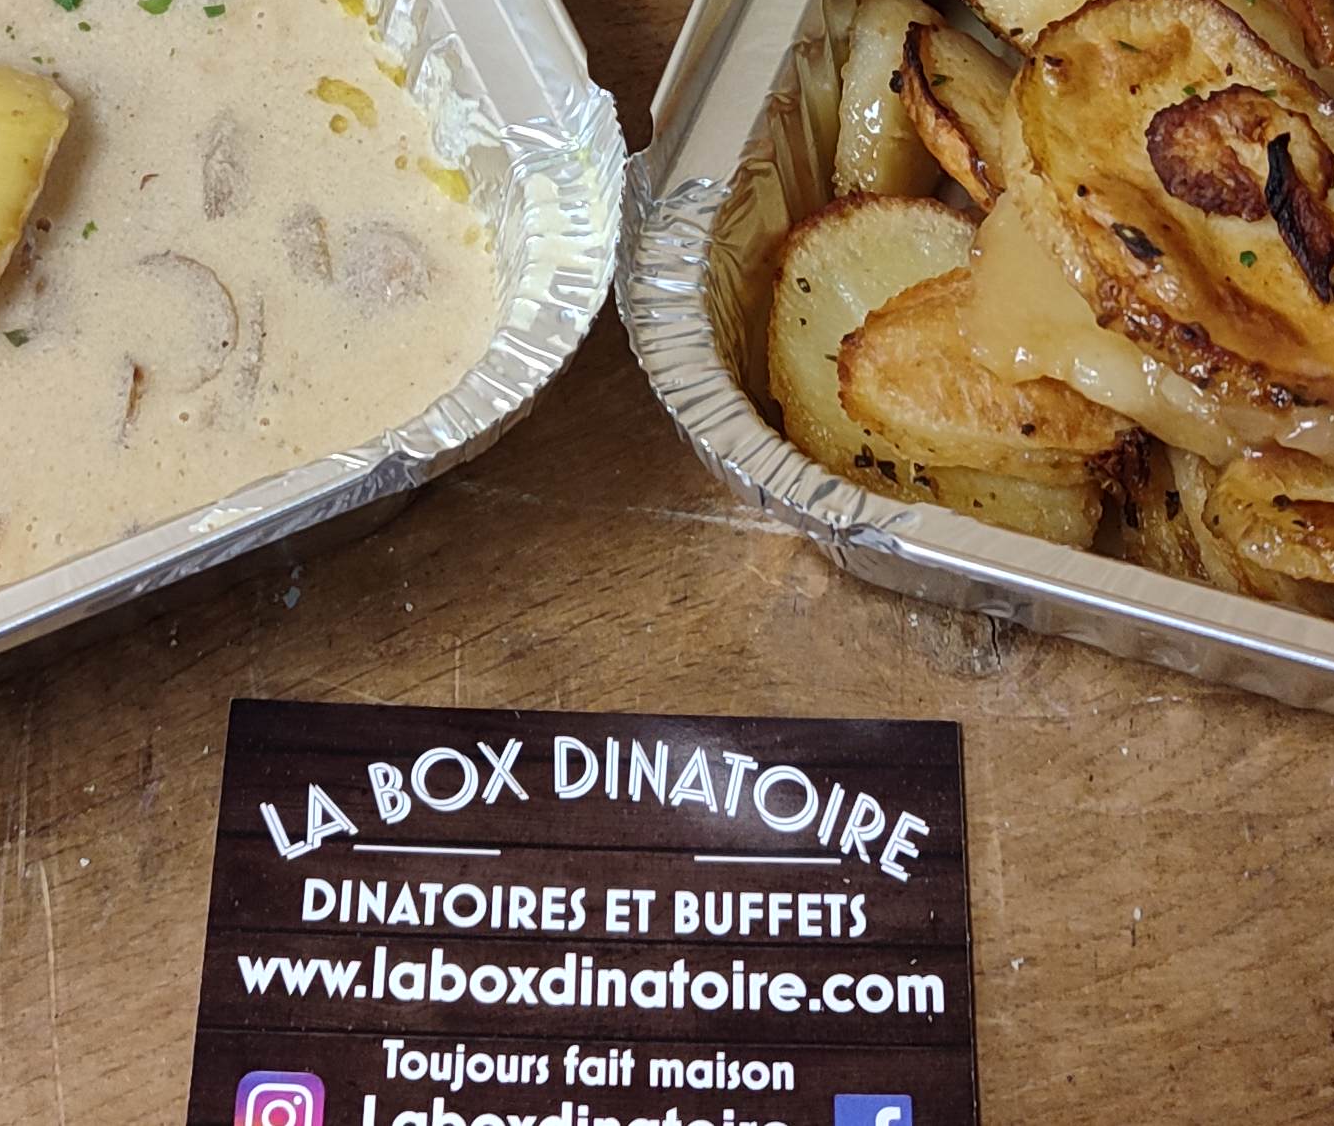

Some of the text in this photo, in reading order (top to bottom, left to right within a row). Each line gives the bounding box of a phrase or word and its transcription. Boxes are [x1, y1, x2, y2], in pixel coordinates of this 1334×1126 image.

[258, 734, 931, 883] LA BOX DINATOIRE
[300, 877, 868, 939] DINATOIRES ET BUFFETS
[236, 944, 946, 1015] www.laboxdinatoire.com
[381, 1037, 796, 1093] Toujours fait maison
